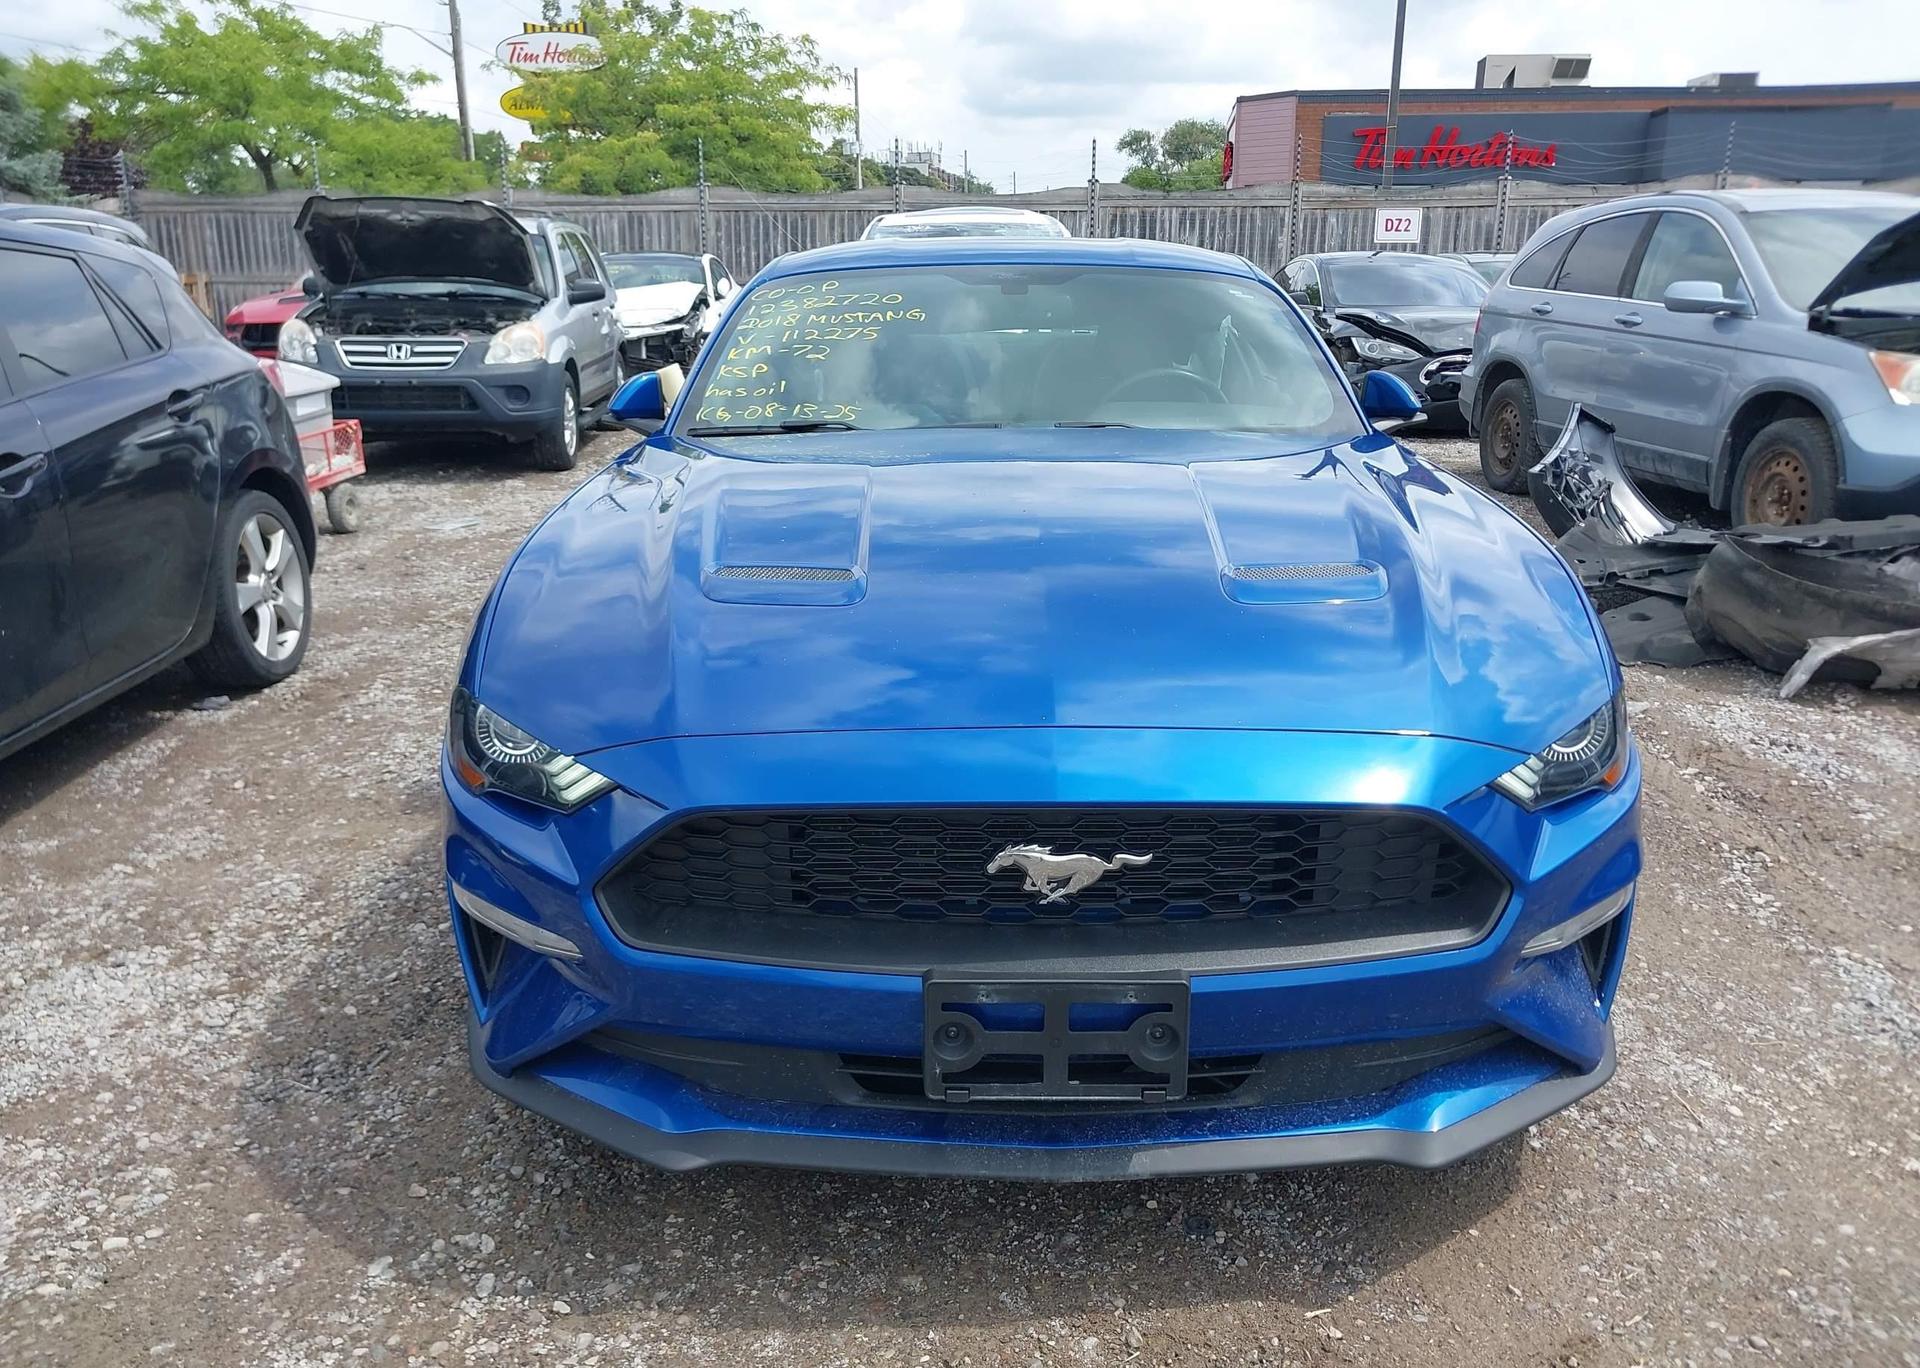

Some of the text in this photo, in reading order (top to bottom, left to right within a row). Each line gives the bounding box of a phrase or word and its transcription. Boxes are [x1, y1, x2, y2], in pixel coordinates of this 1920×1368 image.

[507, 41, 540, 64] Tim
[1353, 124, 1557, 169] Tim Hortons
[1384, 218, 1412, 232] DZ2
[737, 308, 926, 331] 2018 MUSTANG
[753, 381, 786, 396] oil
